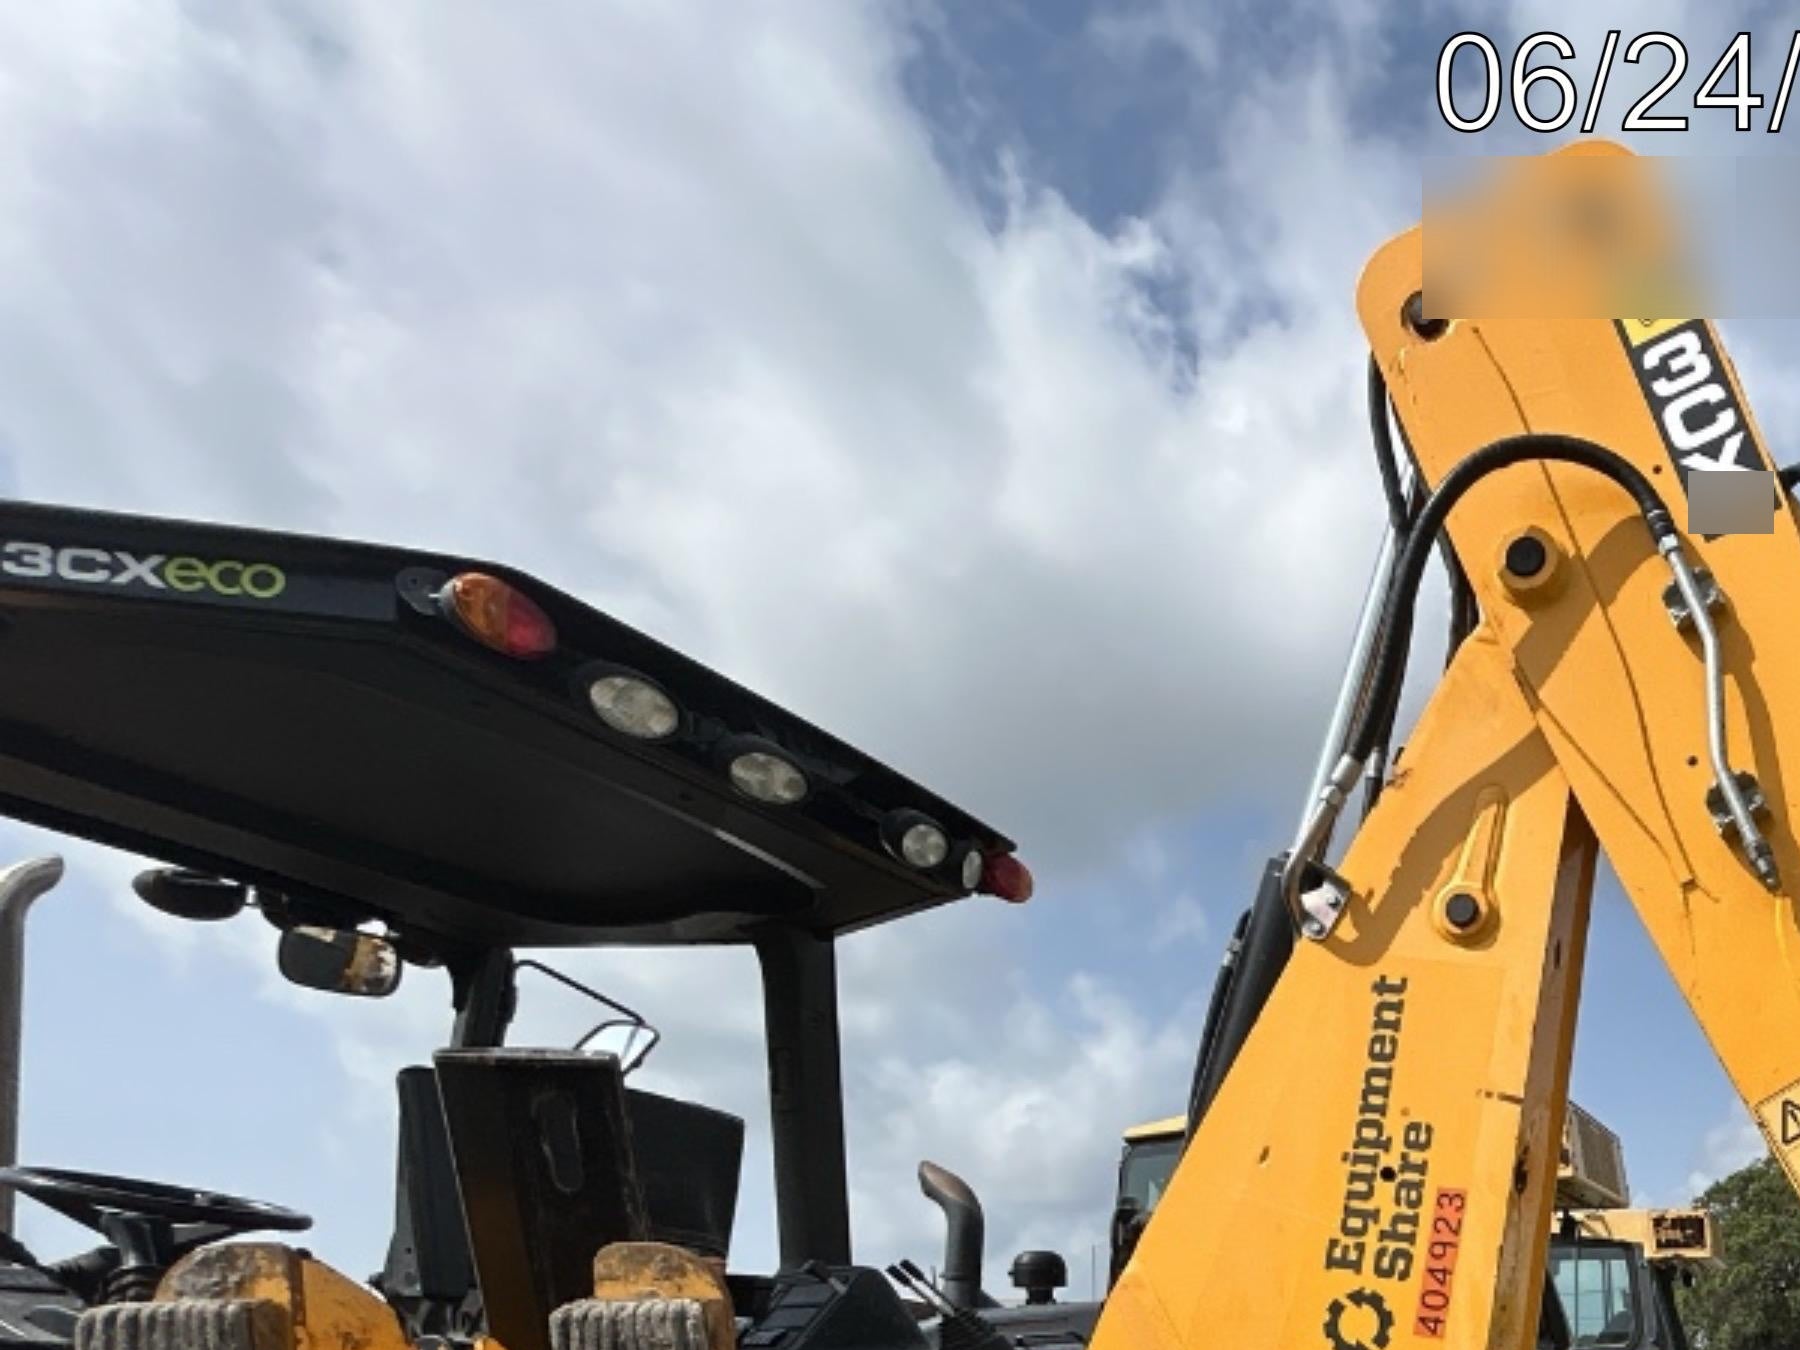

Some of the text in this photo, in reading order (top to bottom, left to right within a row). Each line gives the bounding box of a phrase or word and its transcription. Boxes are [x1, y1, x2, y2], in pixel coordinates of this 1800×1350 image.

[1325, 974, 1408, 1275] Equipment
[1373, 1119, 1434, 1282] Share
[1417, 1192, 1466, 1336] 404923
